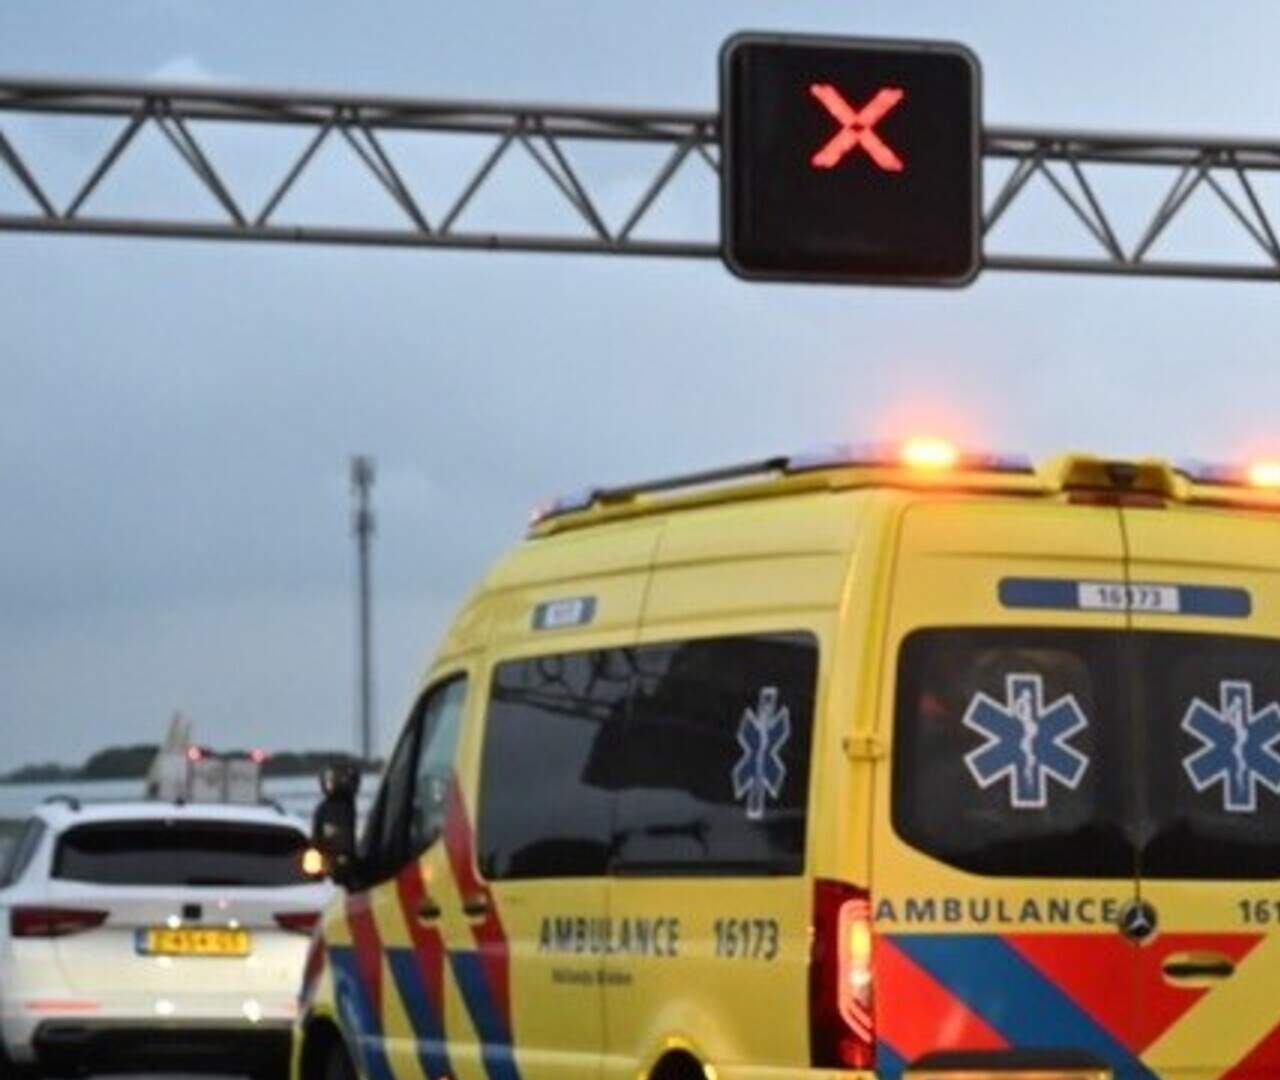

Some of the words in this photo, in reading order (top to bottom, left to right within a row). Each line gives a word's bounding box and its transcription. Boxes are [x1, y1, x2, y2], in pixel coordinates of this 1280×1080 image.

[1096, 585, 1162, 608] 16173
[875, 898, 1116, 924] AMBULANCE
[538, 916, 679, 957] AMBULANCE
[713, 917, 780, 961] 16173
